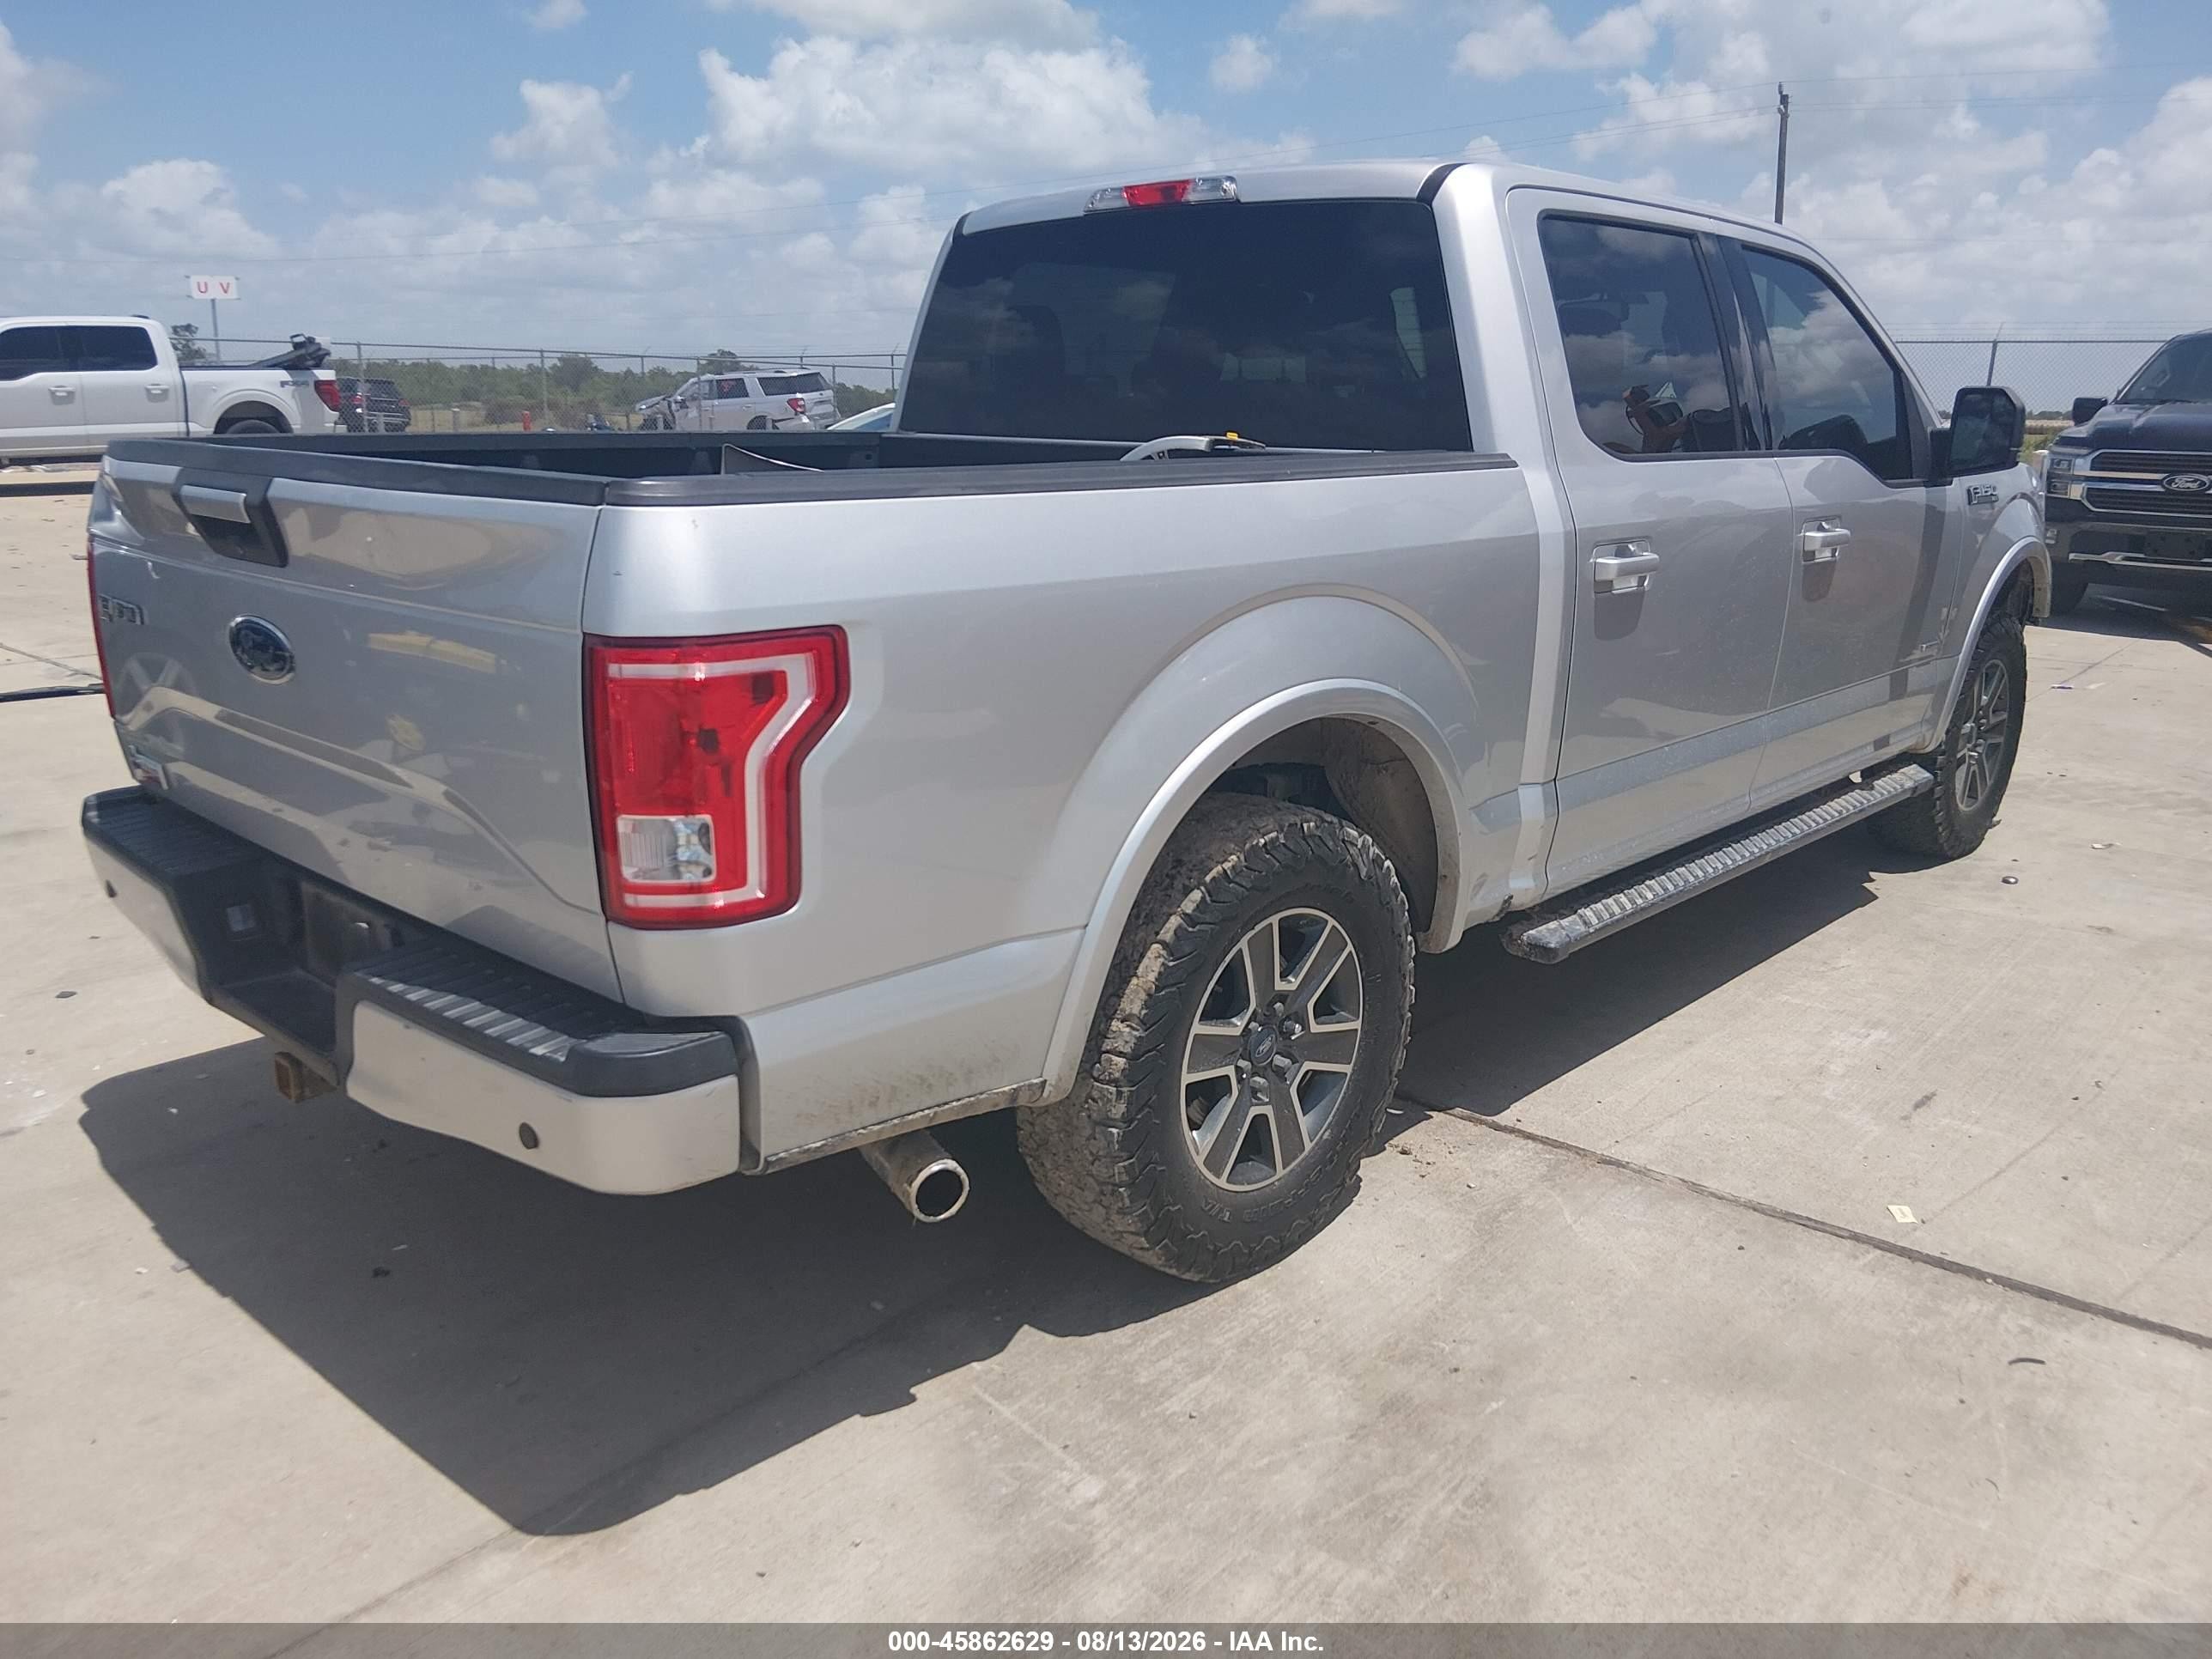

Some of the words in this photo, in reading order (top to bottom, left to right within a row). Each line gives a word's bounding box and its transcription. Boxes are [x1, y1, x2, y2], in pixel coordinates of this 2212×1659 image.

[197, 281, 208, 294] U
[219, 281, 230, 295] V
[2171, 477, 2202, 489] Ford
